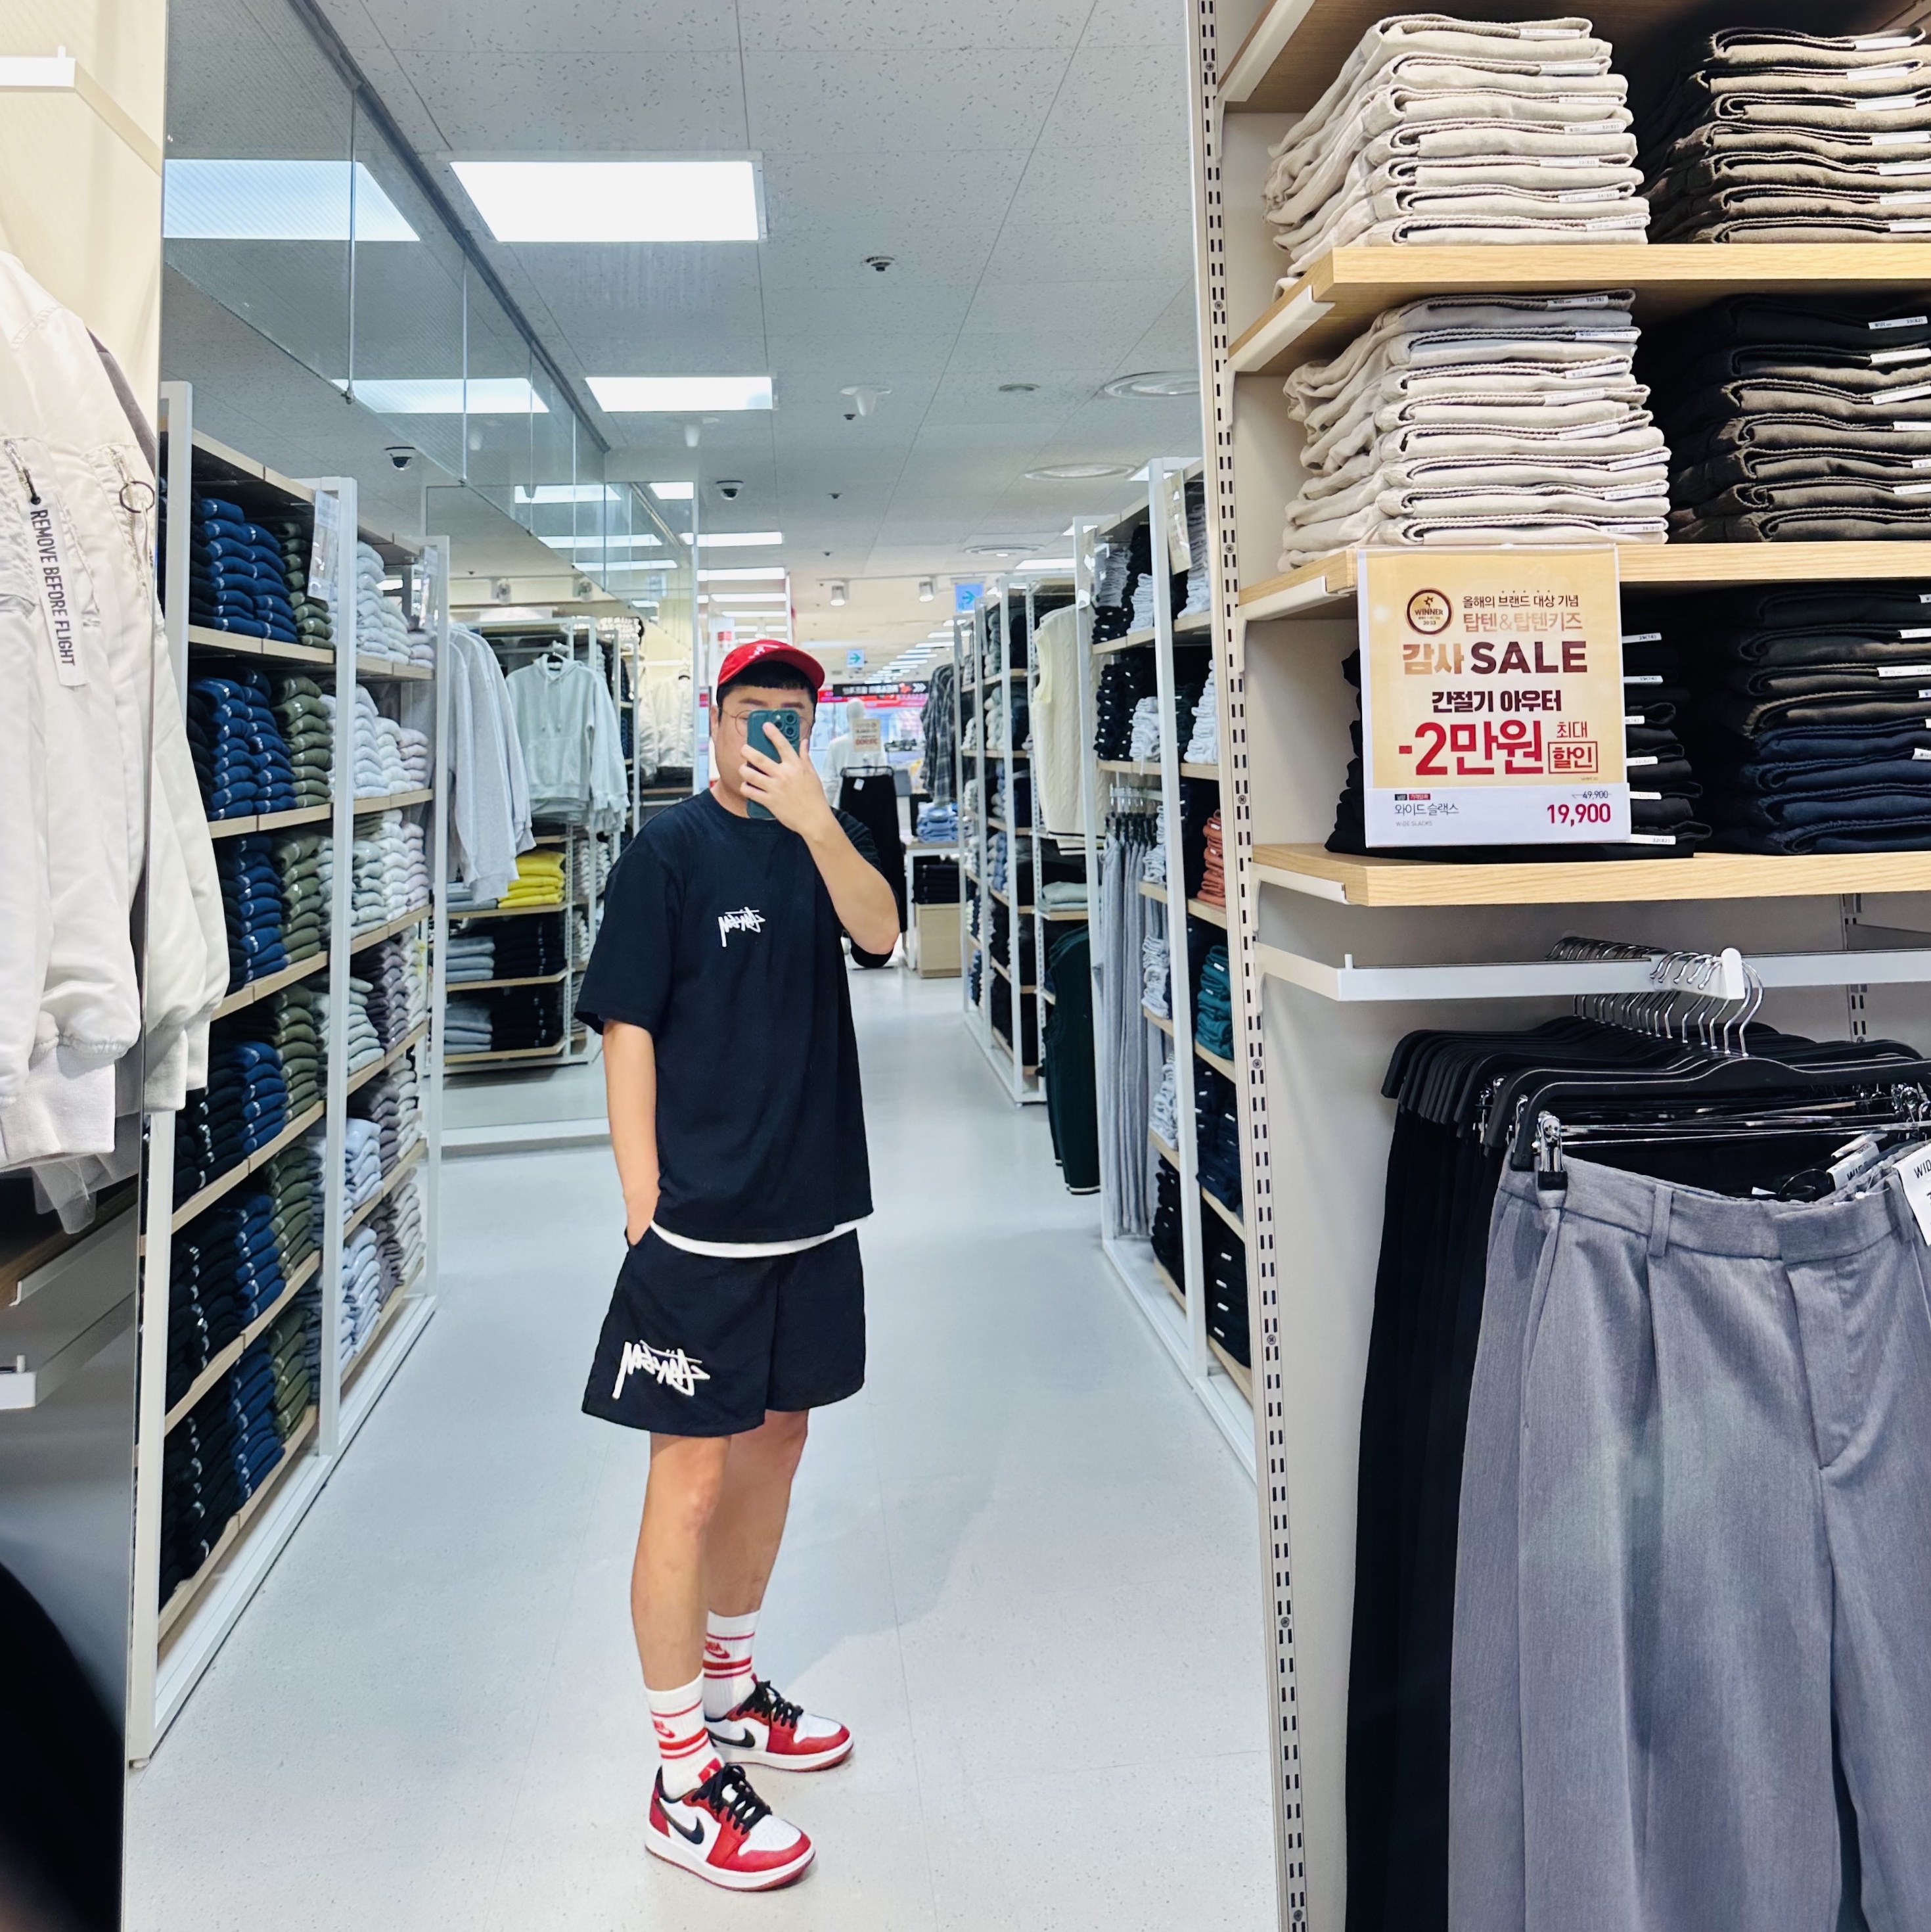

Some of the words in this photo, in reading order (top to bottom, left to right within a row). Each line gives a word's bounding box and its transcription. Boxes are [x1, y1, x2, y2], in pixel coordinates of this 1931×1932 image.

[30, 509, 58, 563] REMOVE
[43, 566, 68, 618] BEFORE
[1463, 595, 1495, 609] 올해의
[1497, 595, 1531, 609] 브랜드
[1533, 595, 1556, 608] 대상
[1558, 594, 1579, 607] 기념
[1463, 611, 1583, 633] 탑텐&탑텐키즈
[54, 620, 76, 666] FLIGHT
[1402, 643, 1465, 676] 감사
[1470, 640, 1588, 676] SALE
[1432, 690, 1494, 714] 간절기
[1500, 689, 1562, 713] 아우터
[1556, 721, 1588, 739] 최대
[1398, 719, 1544, 776] -2만원
[1552, 746, 1593, 770] 할인
[1582, 791, 1608, 800] 49,900
[1394, 803, 1427, 816] 와이드
[1427, 802, 1460, 816] 슬랙스
[1547, 803, 1611, 828] 19,900
